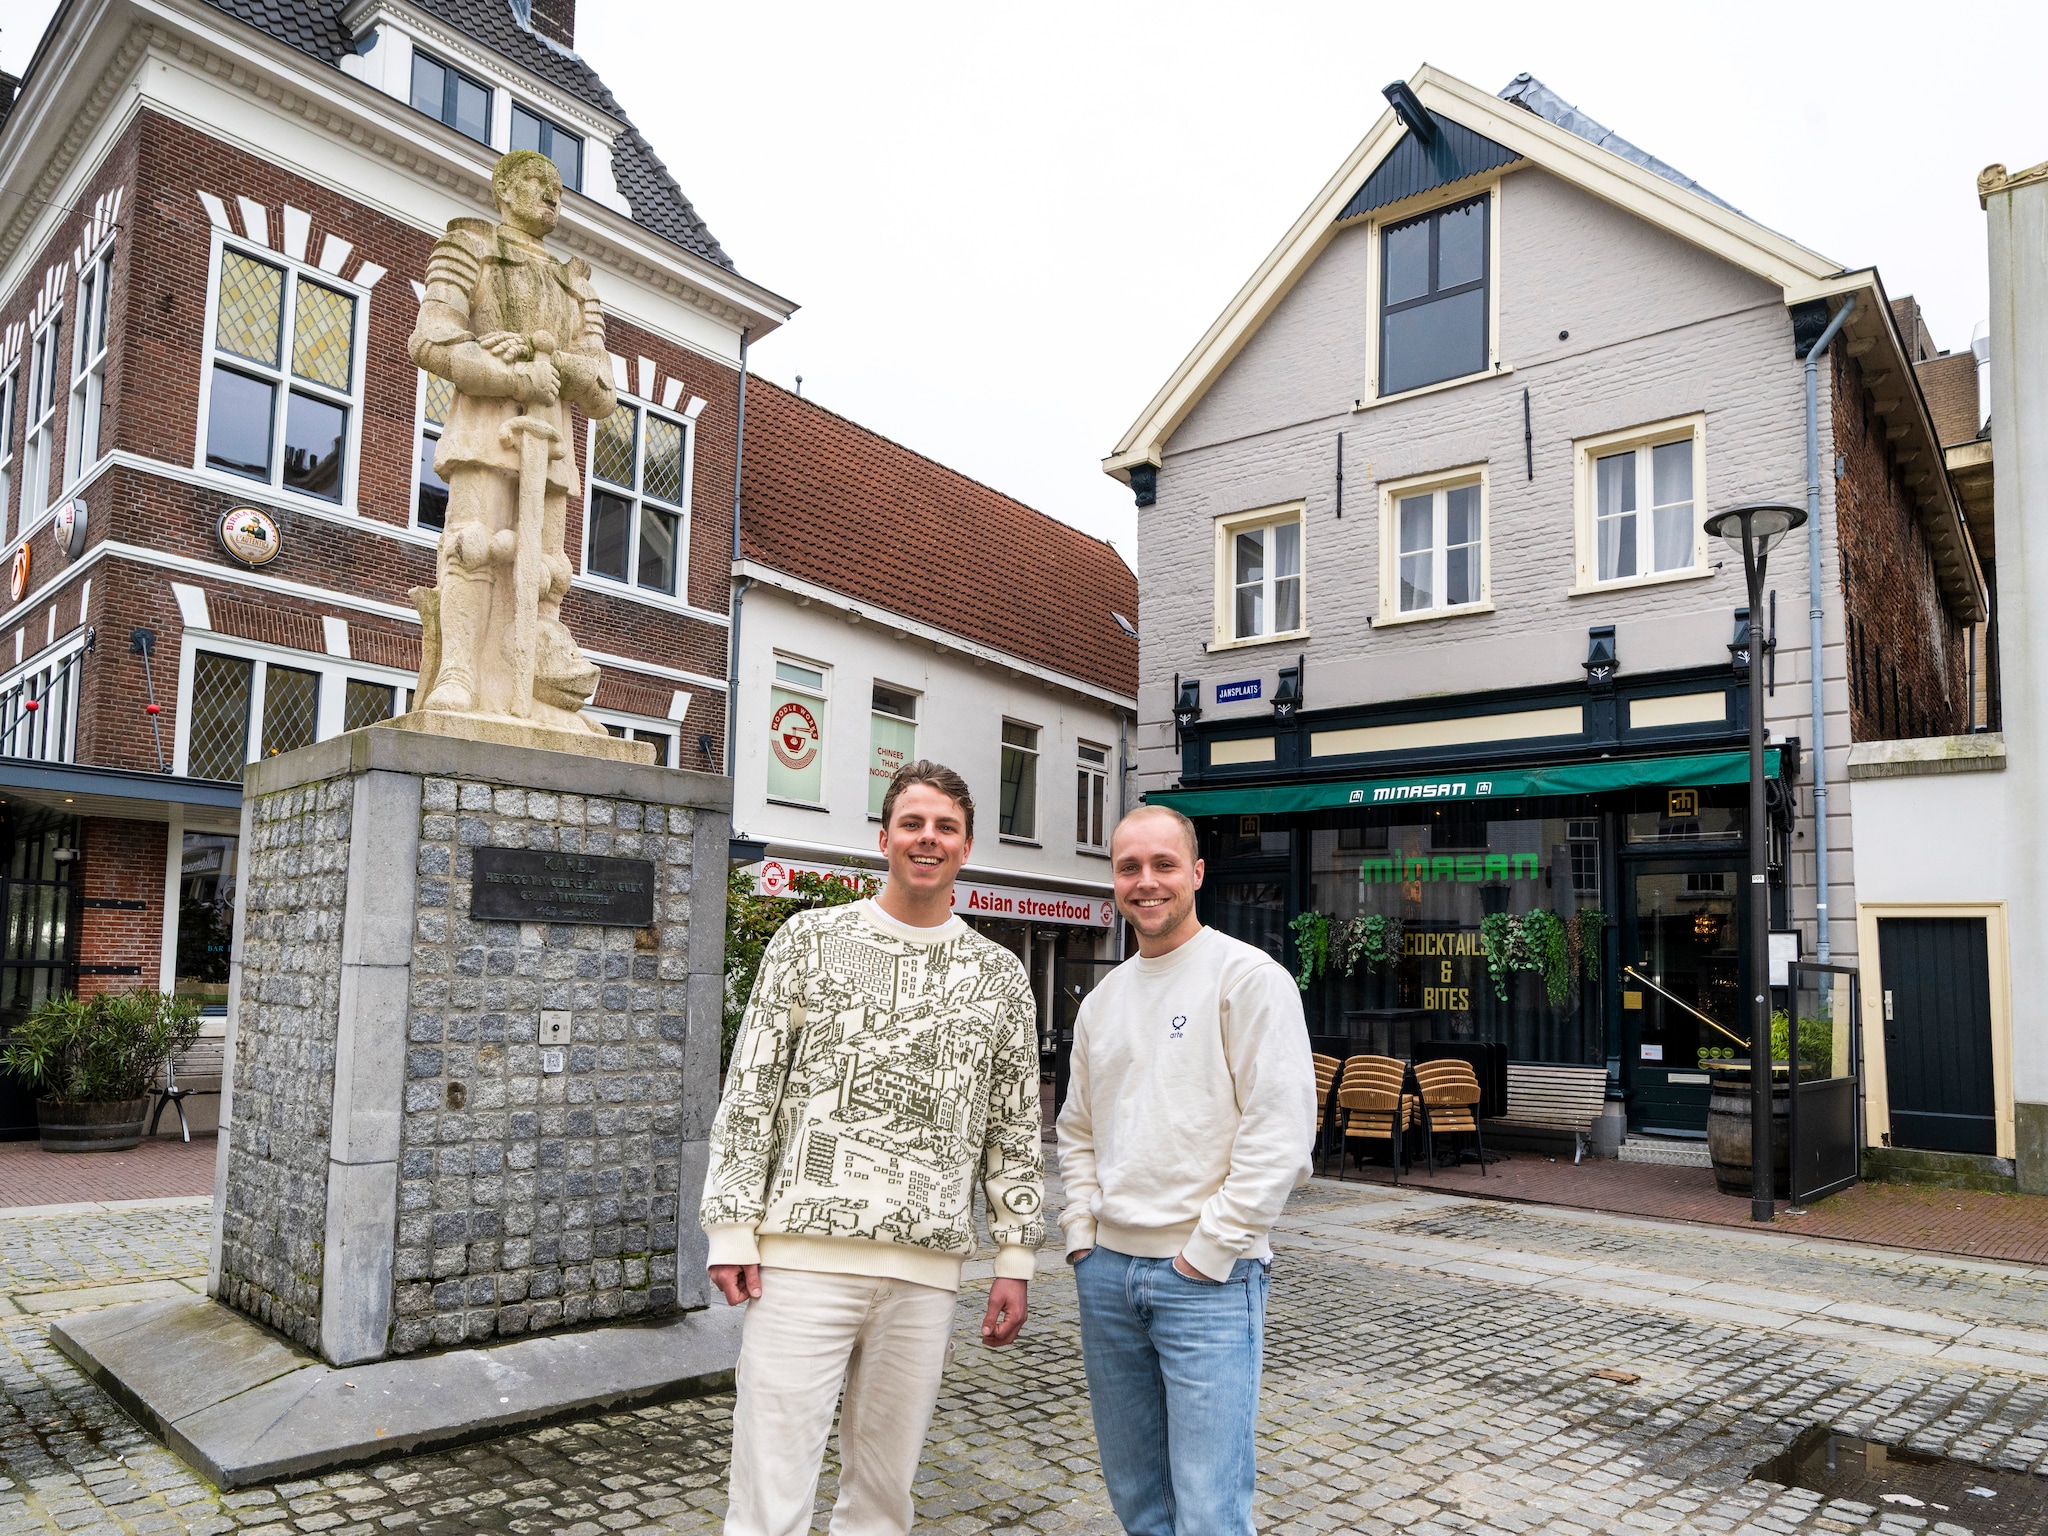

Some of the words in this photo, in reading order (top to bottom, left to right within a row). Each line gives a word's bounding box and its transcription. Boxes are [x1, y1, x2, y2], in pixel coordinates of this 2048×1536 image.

[226, 511, 249, 531] BIRRA
[250, 511, 277, 543] MORETTI
[235, 535, 269, 549] L'AUTENTICA
[1219, 685, 1258, 698] JANSPLAATS
[772, 704, 797, 730] NOODLE
[800, 707, 817, 738] WORKS
[877, 747, 904, 760] CHINEES
[881, 759, 899, 770] THAIS
[543, 855, 596, 873] KAREL
[968, 890, 1012, 912] Asian
[1018, 897, 1090, 920] streetfood
[207, 945, 224, 953] BAR
[1441, 960, 1453, 983] &
[1424, 987, 1470, 1011] BITES
